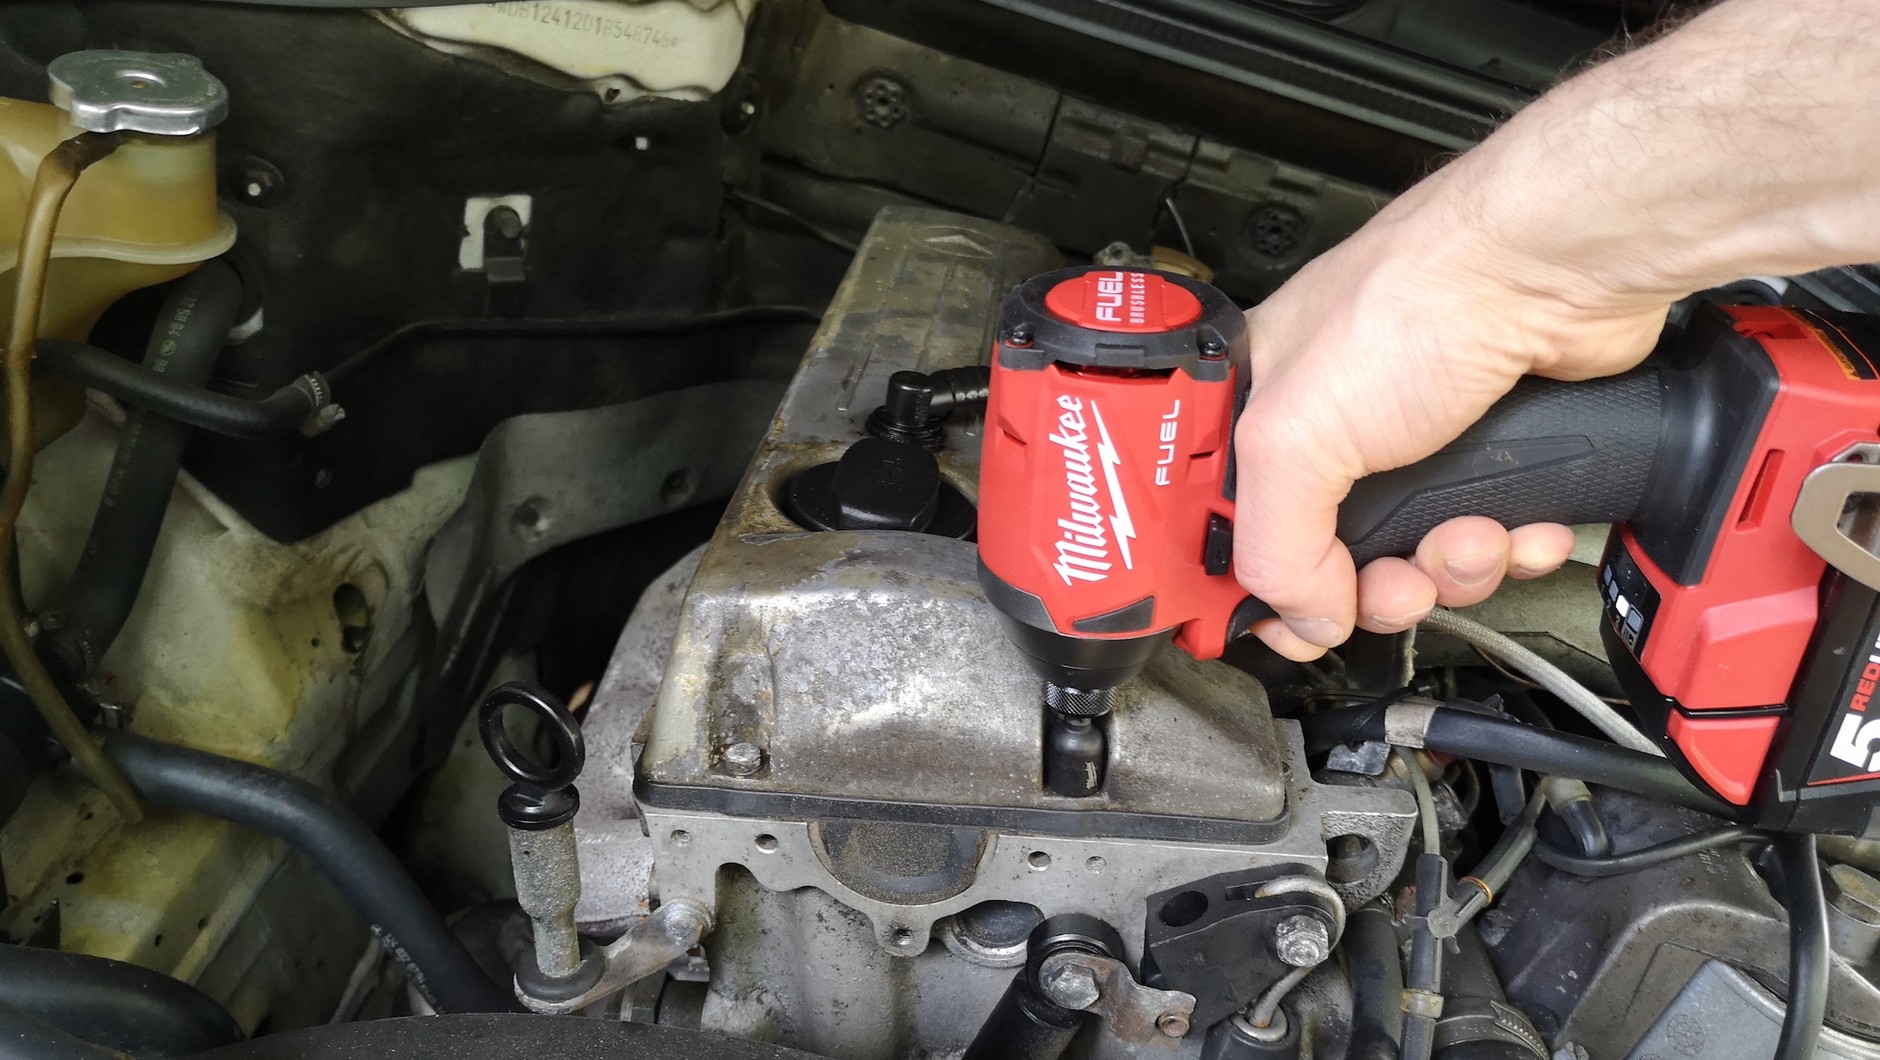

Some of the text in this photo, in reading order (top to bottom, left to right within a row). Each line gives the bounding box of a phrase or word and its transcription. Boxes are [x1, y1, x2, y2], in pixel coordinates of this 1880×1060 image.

[1095, 271, 1123, 322] FUEL
[1129, 272, 1145, 324] BRUSHLESS
[1155, 400, 1180, 486] FUEL
[1049, 394, 1112, 587] Milwaukee
